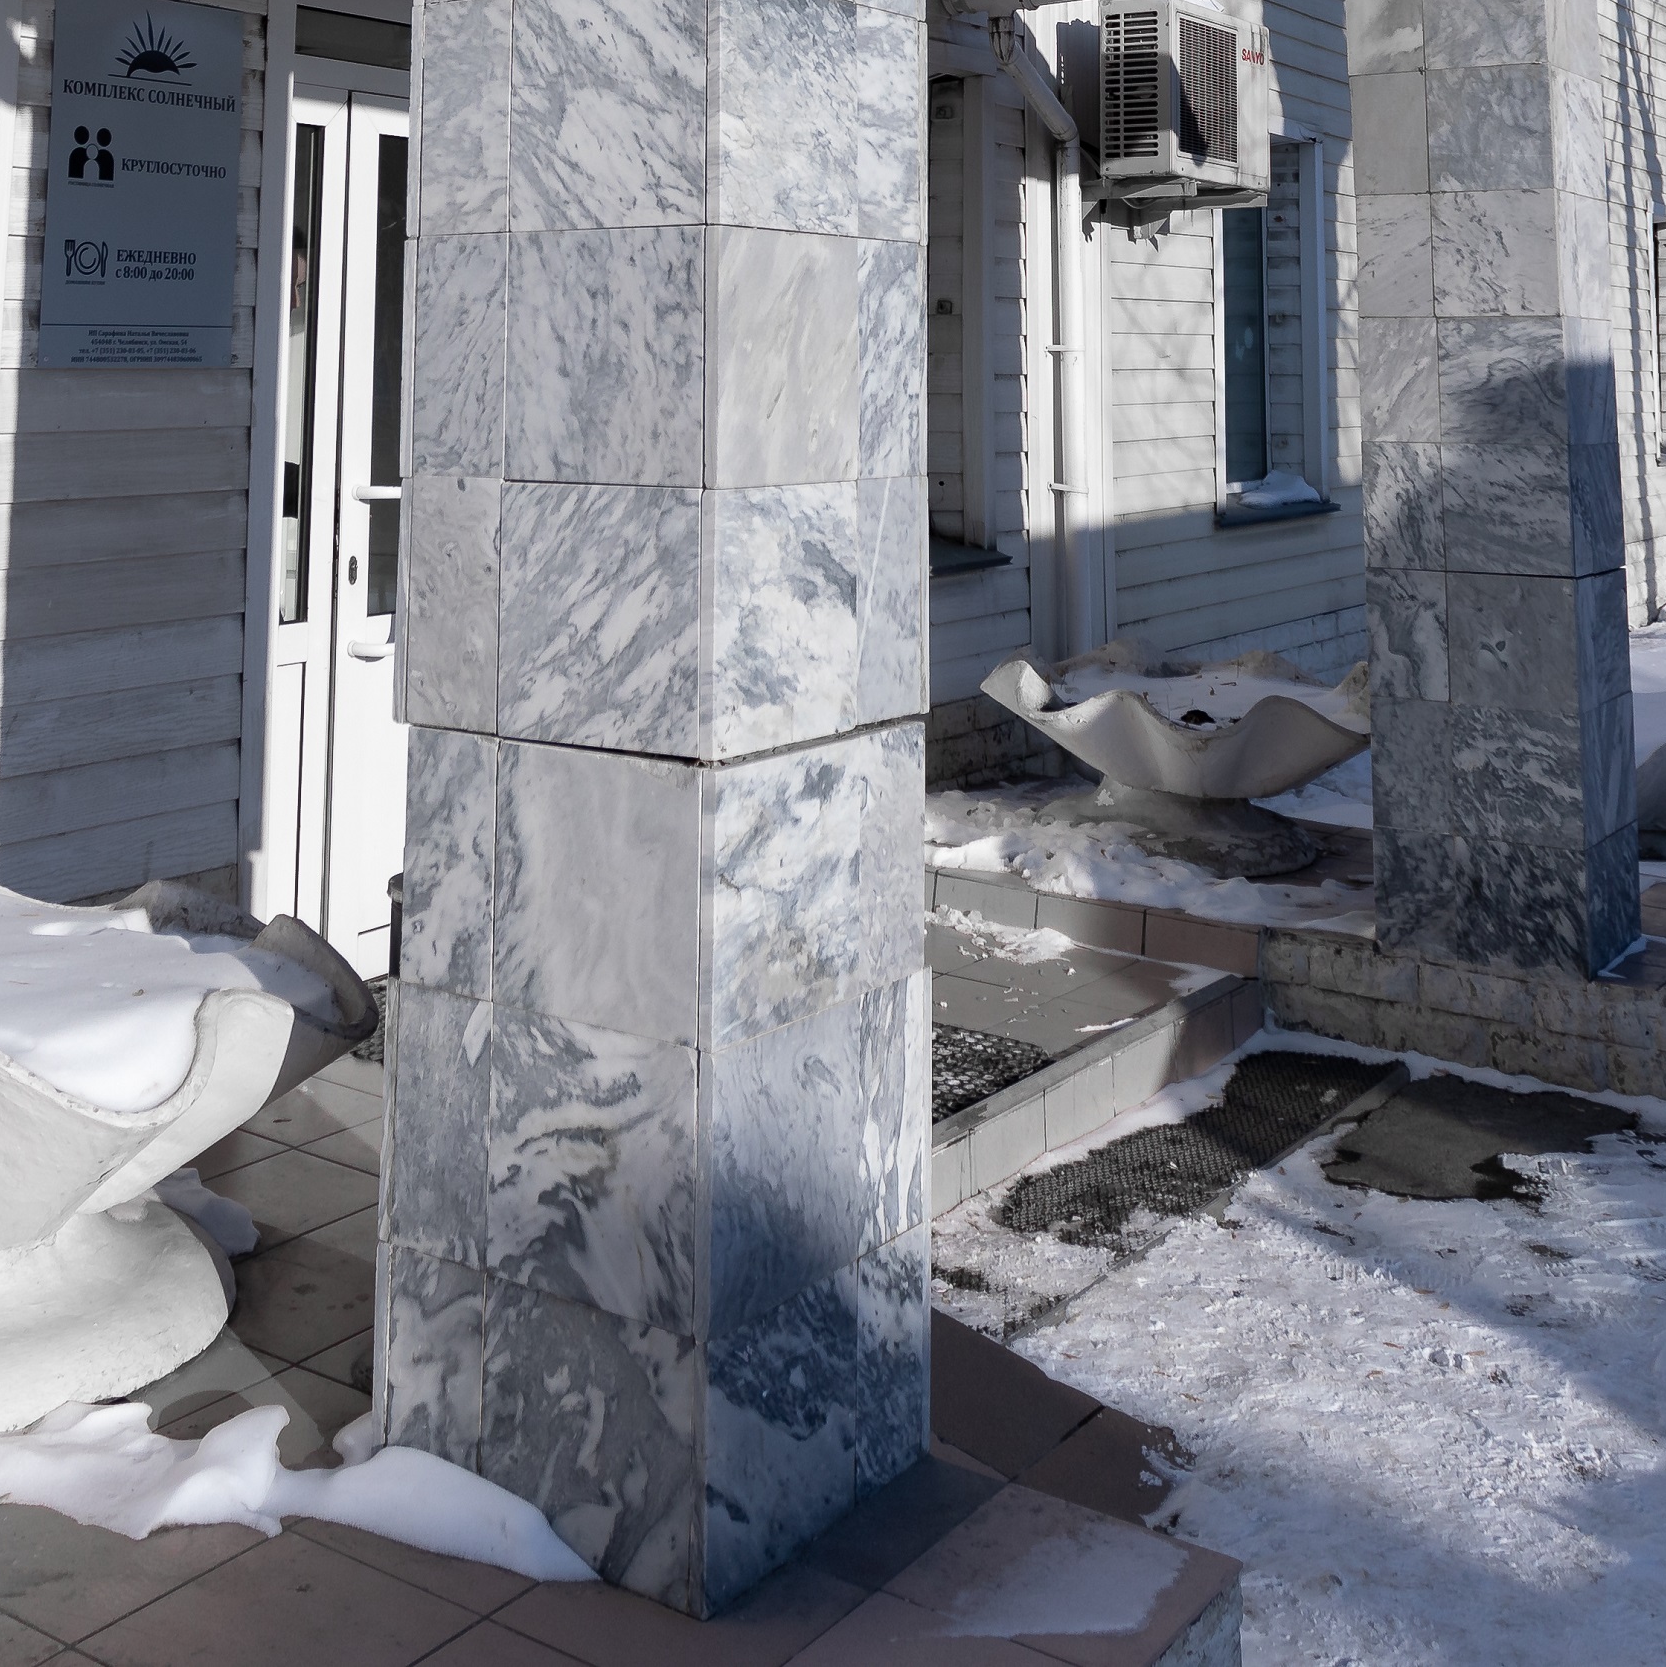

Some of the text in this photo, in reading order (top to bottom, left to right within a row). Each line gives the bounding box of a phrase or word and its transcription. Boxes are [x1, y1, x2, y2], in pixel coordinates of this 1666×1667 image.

[63, 79, 236, 113] КОМПЛЕКС СОЛНЕЧНЫЙ
[121, 157, 226, 179] КРУГЛОСУТОЧНО
[116, 249, 196, 266] ЕЖЕДНЕВНО
[122, 266, 148, 280] 8:00
[149, 268, 163, 282] до
[165, 267, 195, 281] 20:00
